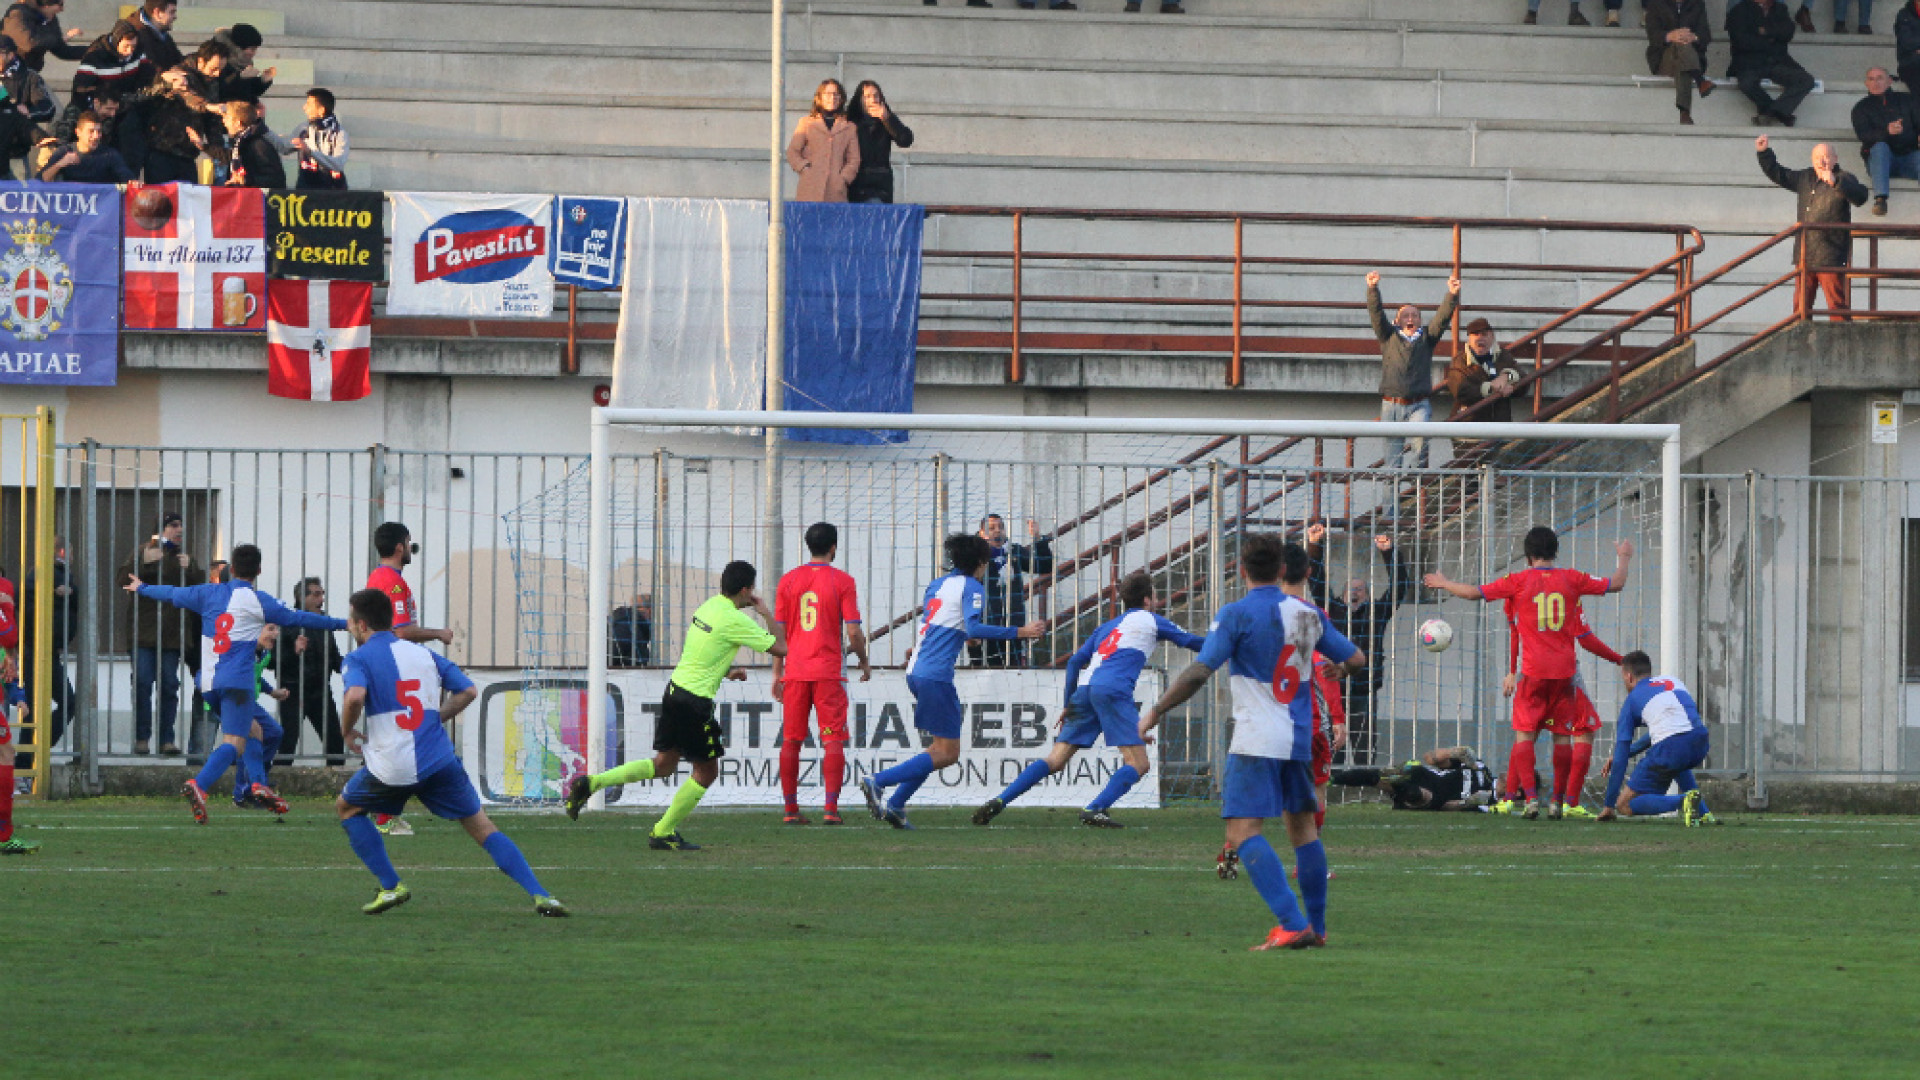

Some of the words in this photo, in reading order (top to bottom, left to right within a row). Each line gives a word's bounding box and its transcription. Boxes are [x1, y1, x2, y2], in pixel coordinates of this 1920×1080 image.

[0, 191, 98, 216] CINUM
[268, 193, 373, 229] Mauro
[275, 231, 371, 266] Presente
[427, 227, 537, 273] Pavesini
[591, 228, 608, 239] no
[134, 244, 162, 262] Via
[225, 245, 255, 264] 137
[0, 352, 82, 376] APIAE
[800, 590, 819, 632] 6
[919, 598, 944, 636] 7
[1533, 592, 1566, 632] 10
[212, 612, 235, 654] 8
[1272, 643, 1301, 705] 6
[395, 678, 425, 732] 5
[938, 758, 988, 787] ON
[1000, 757, 1126, 787] DMAN
